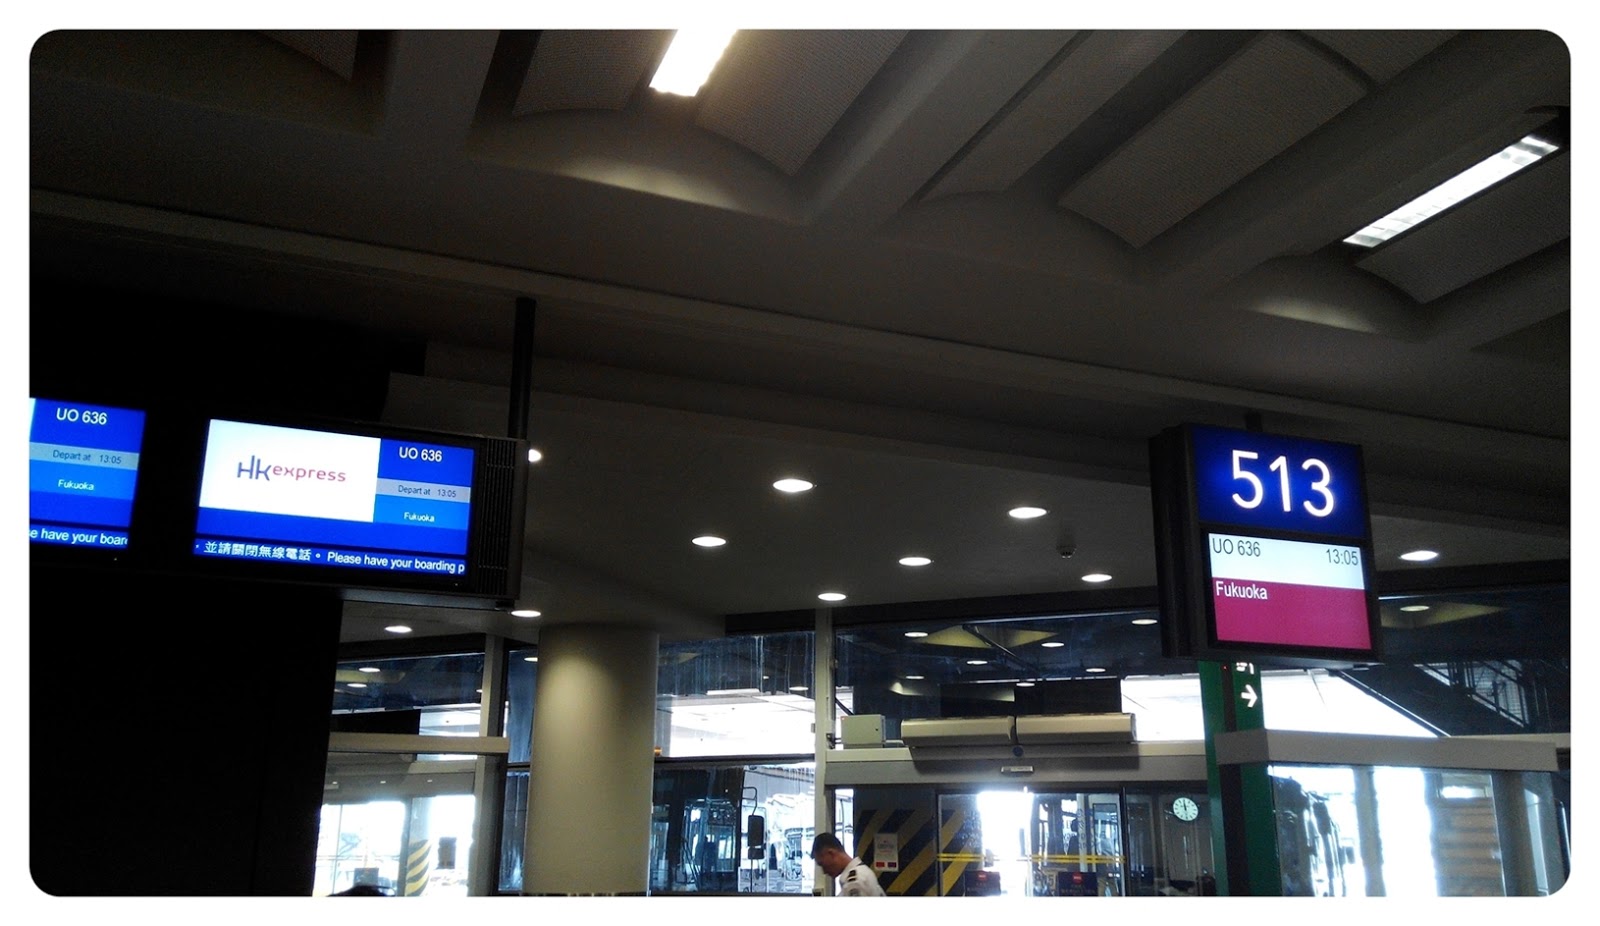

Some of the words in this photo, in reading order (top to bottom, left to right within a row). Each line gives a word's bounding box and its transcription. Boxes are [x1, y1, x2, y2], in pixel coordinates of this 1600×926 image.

[56, 408, 79, 422] UO
[82, 410, 107, 425] 636
[52, 449, 81, 462] Depart
[99, 454, 122, 465] 13:05
[398, 446, 418, 460] UO
[420, 449, 442, 462] 636
[57, 479, 95, 491] Fukuoka
[397, 484, 422, 495] Depart
[423, 488, 431, 496] at
[437, 488, 457, 498] 13:05
[1232, 449, 1335, 518] 513
[403, 511, 435, 522] Fukuoka
[41, 528, 70, 541] have
[71, 532, 98, 544] your
[1212, 538, 1234, 554] UO
[1237, 540, 1261, 557] 636
[1325, 548, 1359, 566] 13:05
[327, 551, 362, 565] Please
[364, 555, 389, 567] have
[390, 558, 412, 569] your
[414, 558, 456, 574] boarding
[457, 563, 465, 574] p
[1216, 580, 1268, 600] Fukuoka
